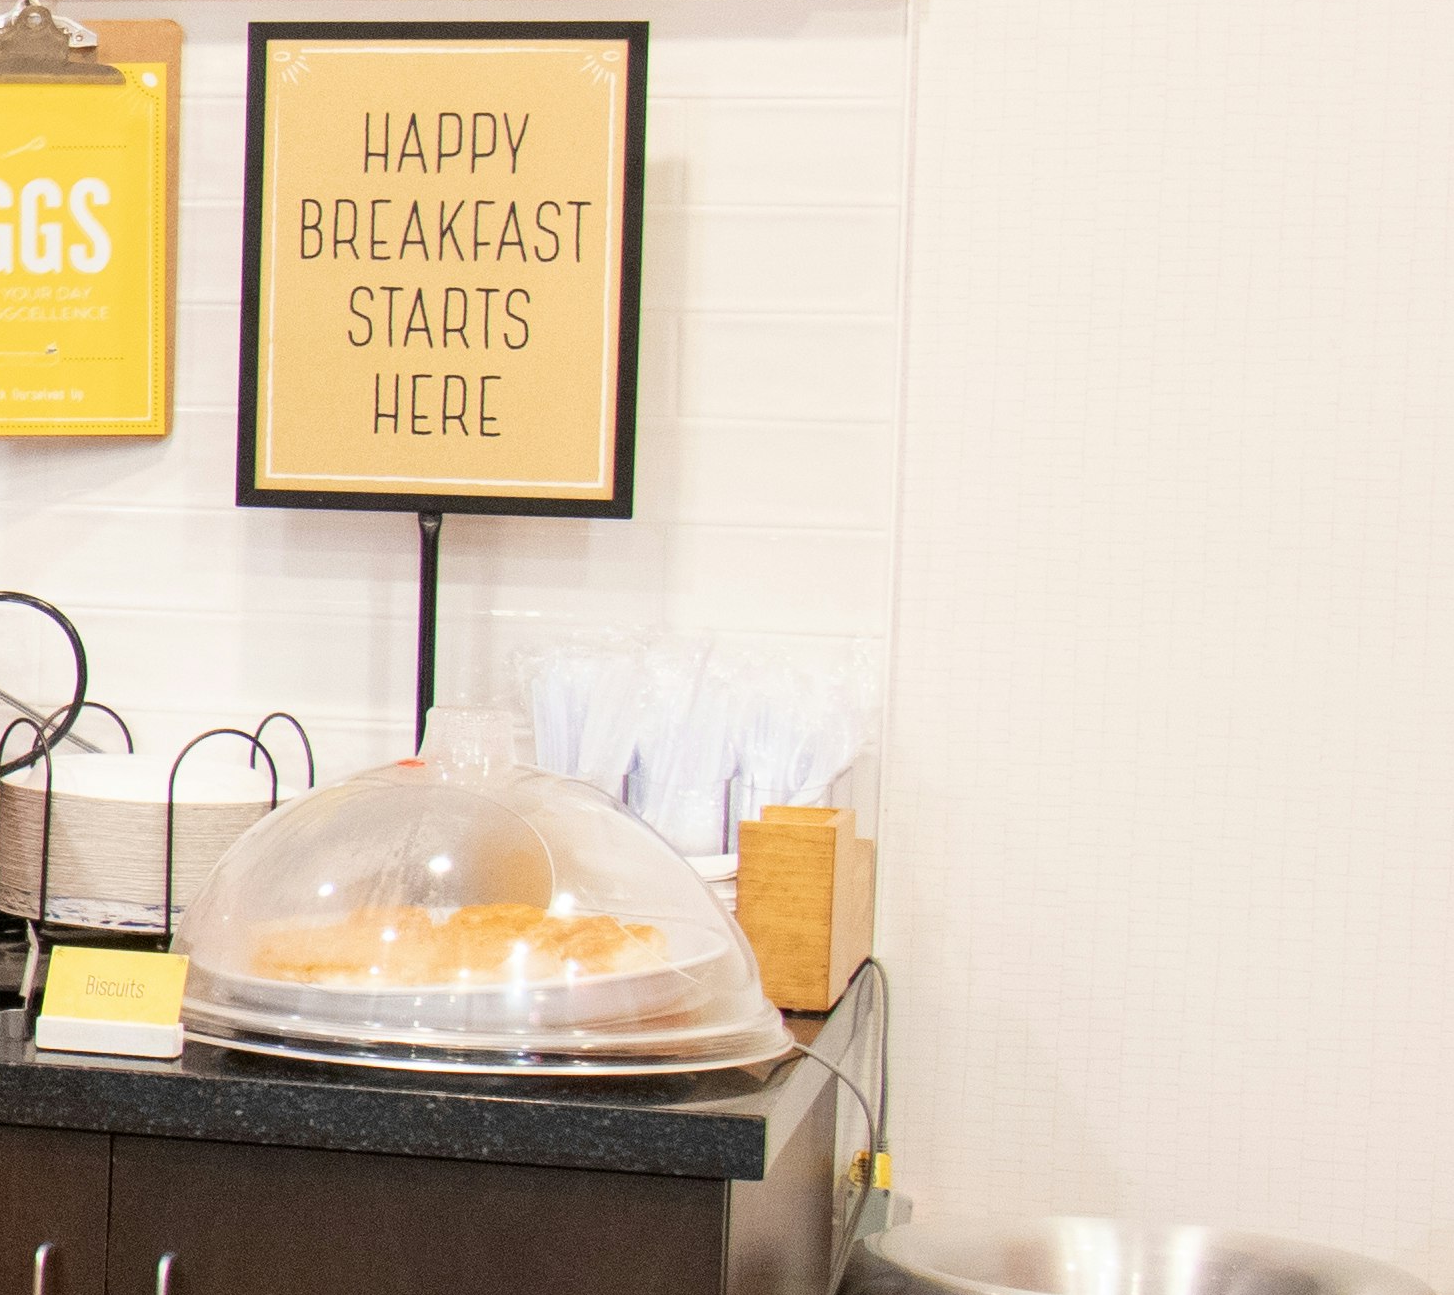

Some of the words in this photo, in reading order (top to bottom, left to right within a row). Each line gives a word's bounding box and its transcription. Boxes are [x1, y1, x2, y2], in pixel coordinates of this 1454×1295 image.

[363, 112, 530, 174] HAPPY
[300, 198, 592, 263] BREAKFAST
[3, 286, 53, 301] YOUR
[57, 286, 94, 301] DAY
[347, 285, 531, 350] STARTS
[373, 372, 502, 438] HERE
[85, 975, 145, 999] Biscuits
